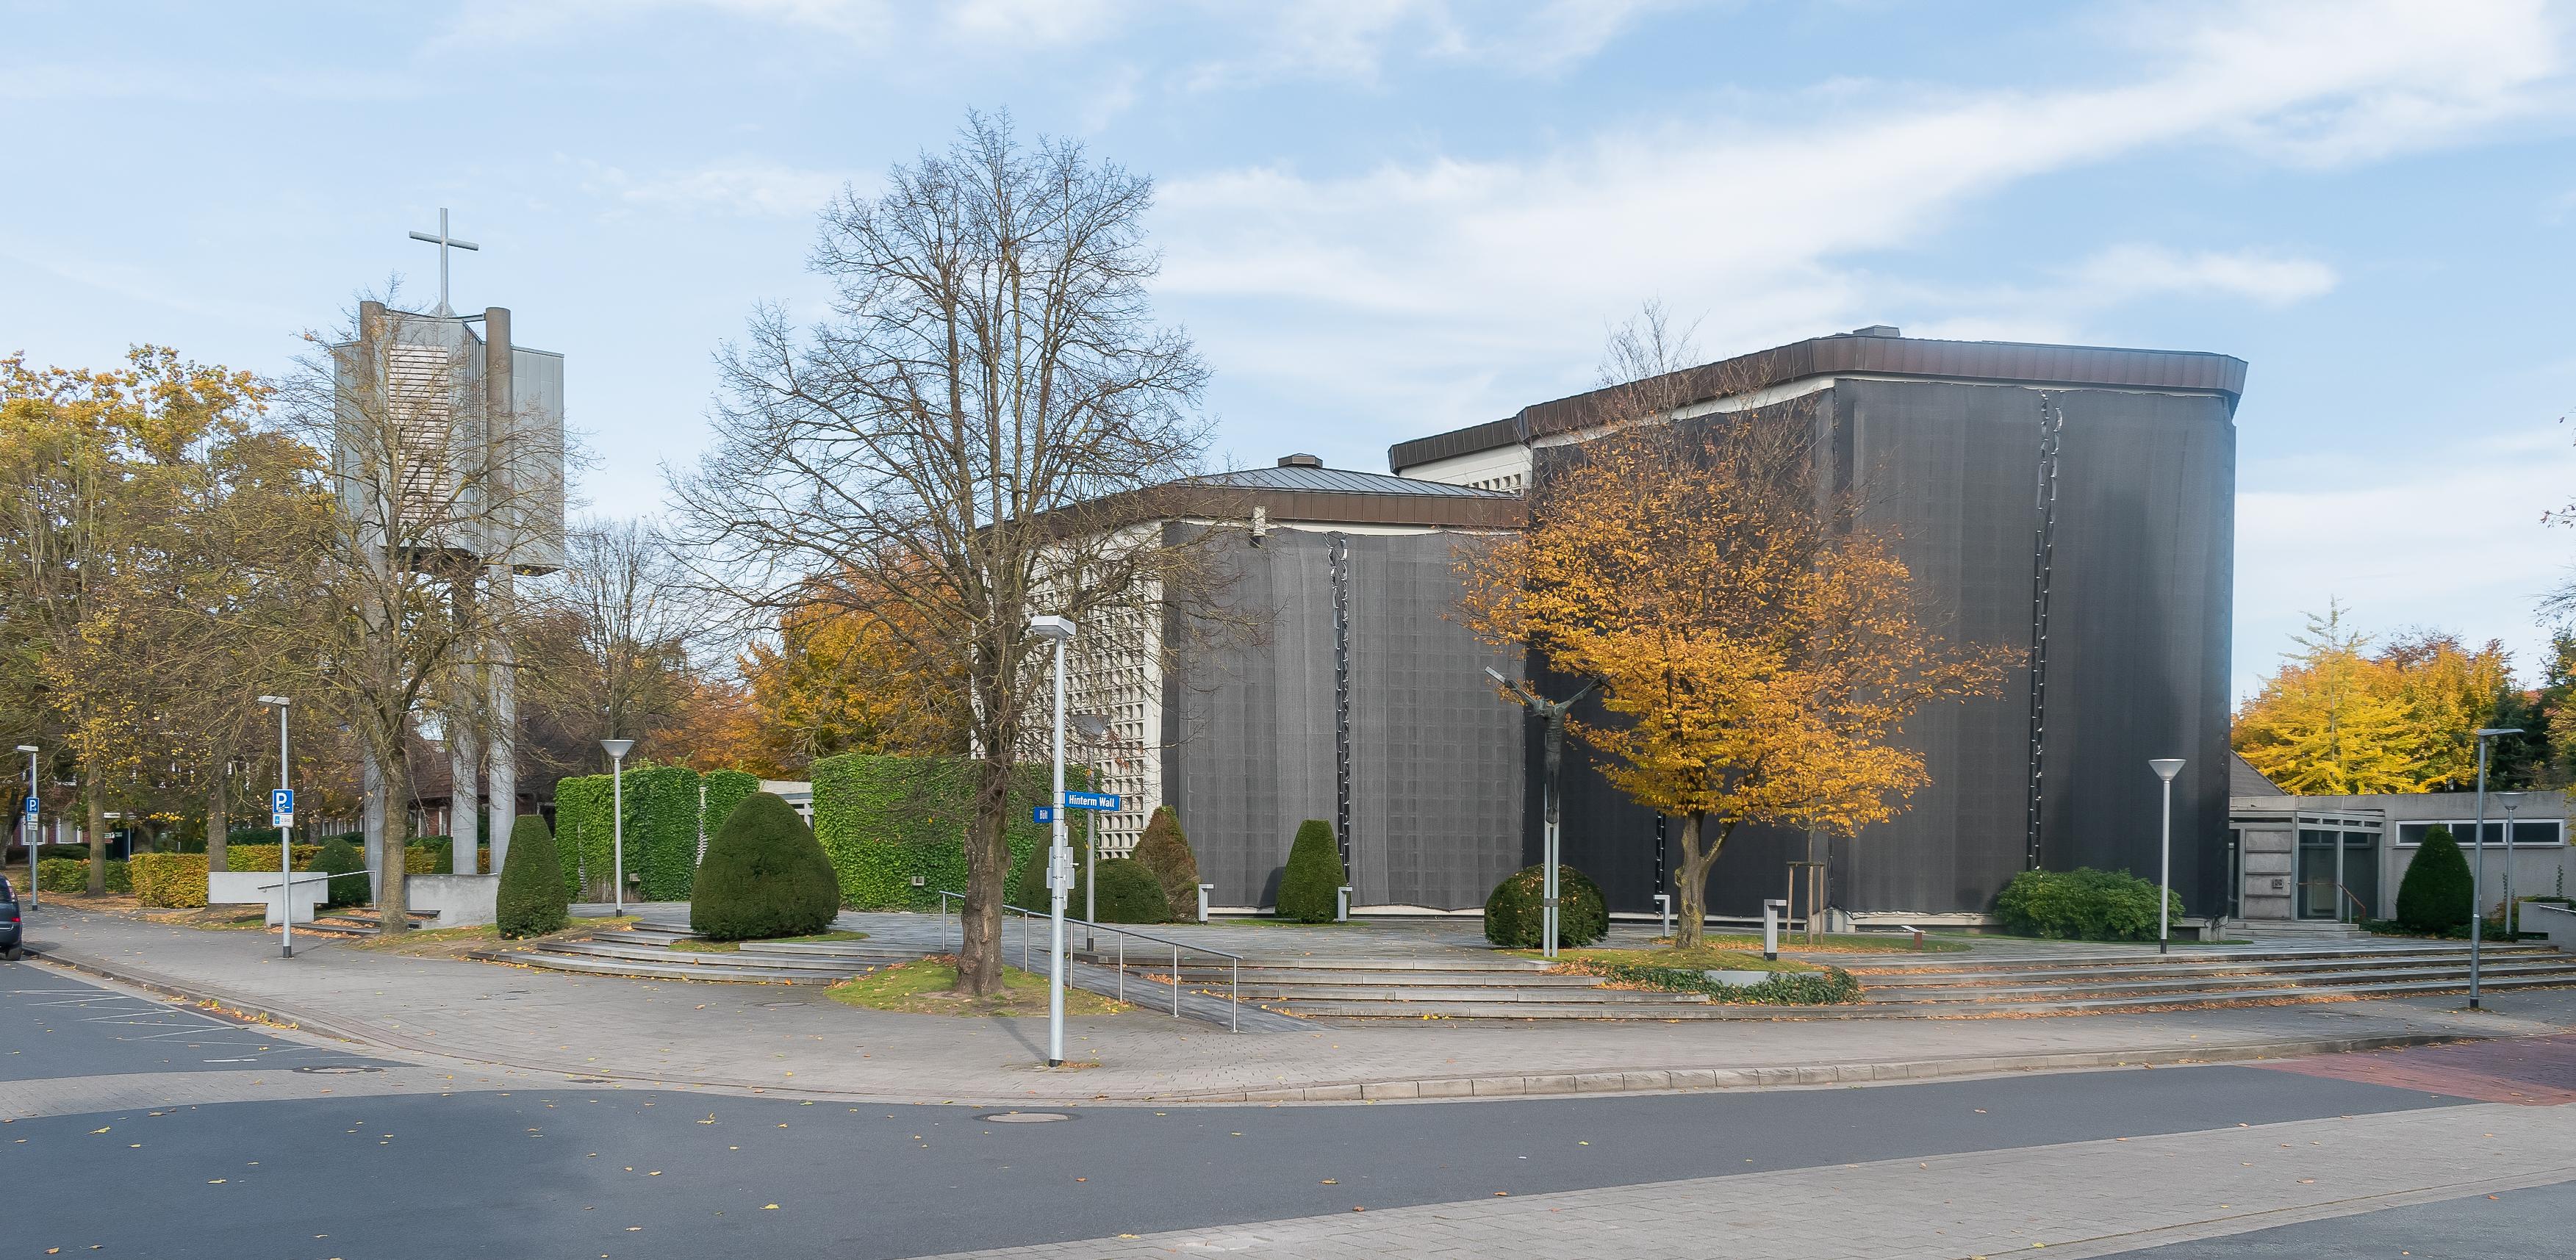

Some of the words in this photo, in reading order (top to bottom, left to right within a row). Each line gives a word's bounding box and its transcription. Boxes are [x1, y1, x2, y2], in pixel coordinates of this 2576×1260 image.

[29, 799, 37, 811] P
[276, 792, 287, 810] P
[1069, 794, 1097, 807] Hinterm
[1099, 796, 1115, 808] Wall
